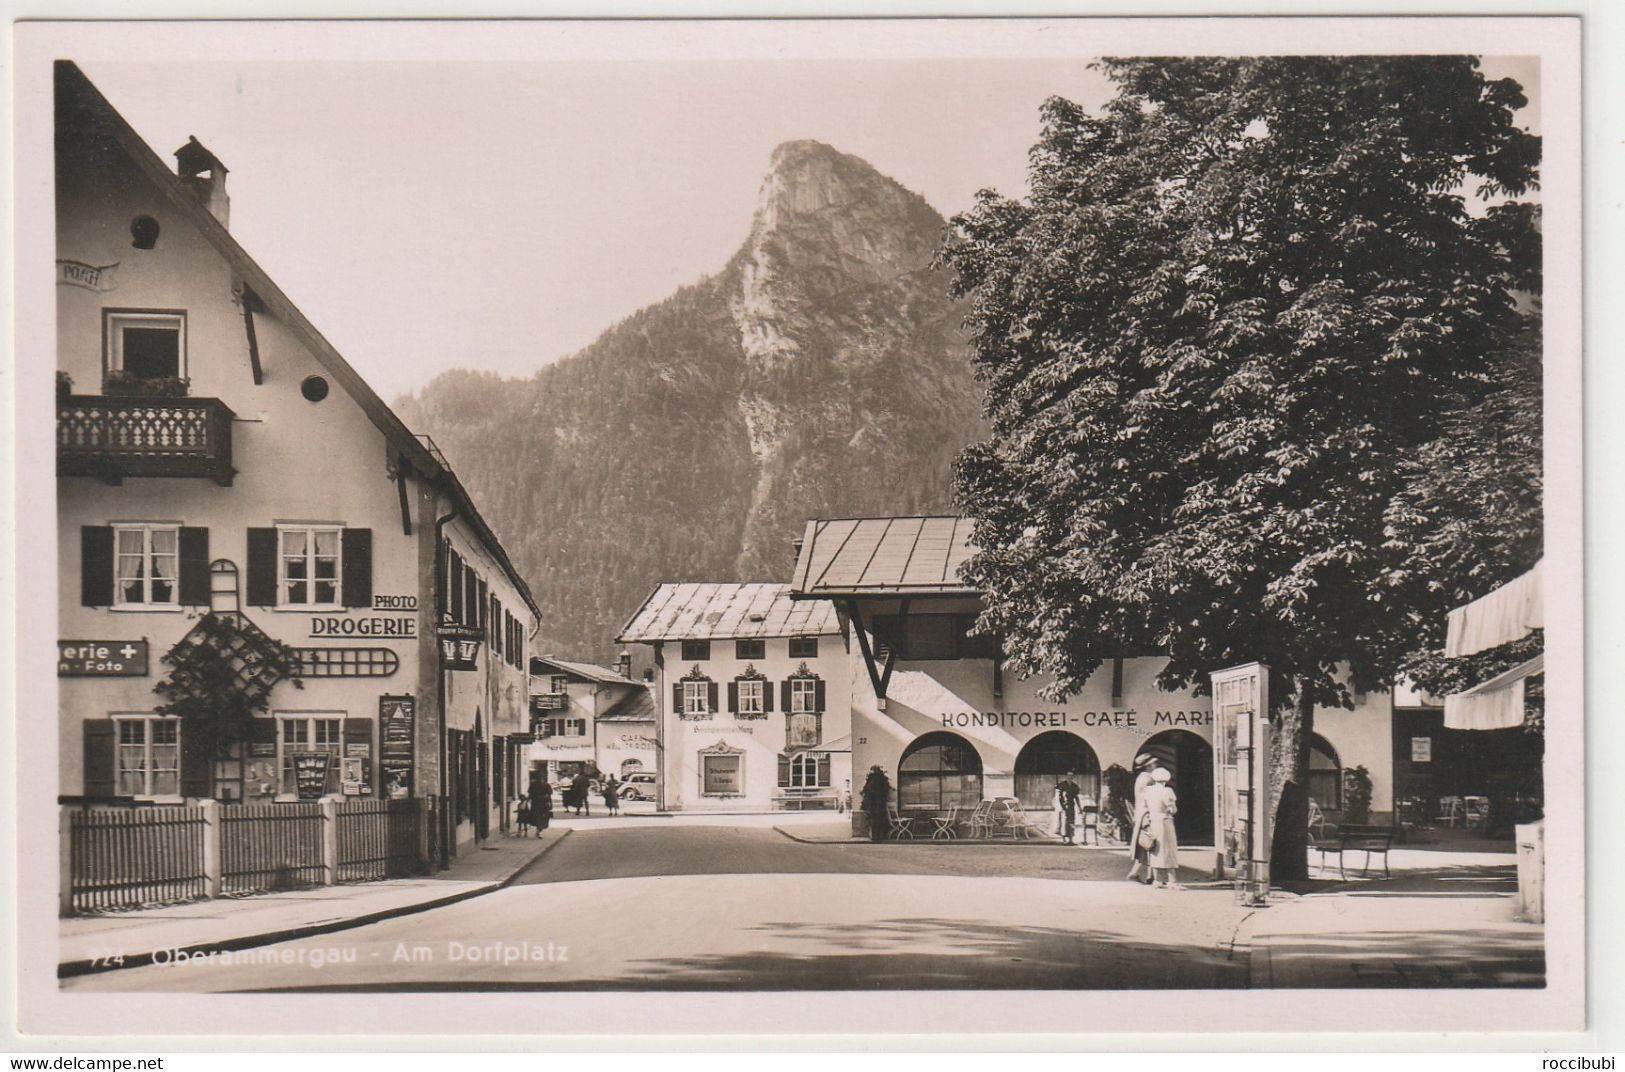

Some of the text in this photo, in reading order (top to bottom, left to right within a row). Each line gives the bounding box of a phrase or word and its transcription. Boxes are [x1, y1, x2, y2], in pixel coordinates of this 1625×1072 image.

[374, 595, 417, 608] PHOTO
[312, 617, 415, 635] DROGERIE
[63, 643, 109, 659] erie
[85, 661, 123, 671] Foto
